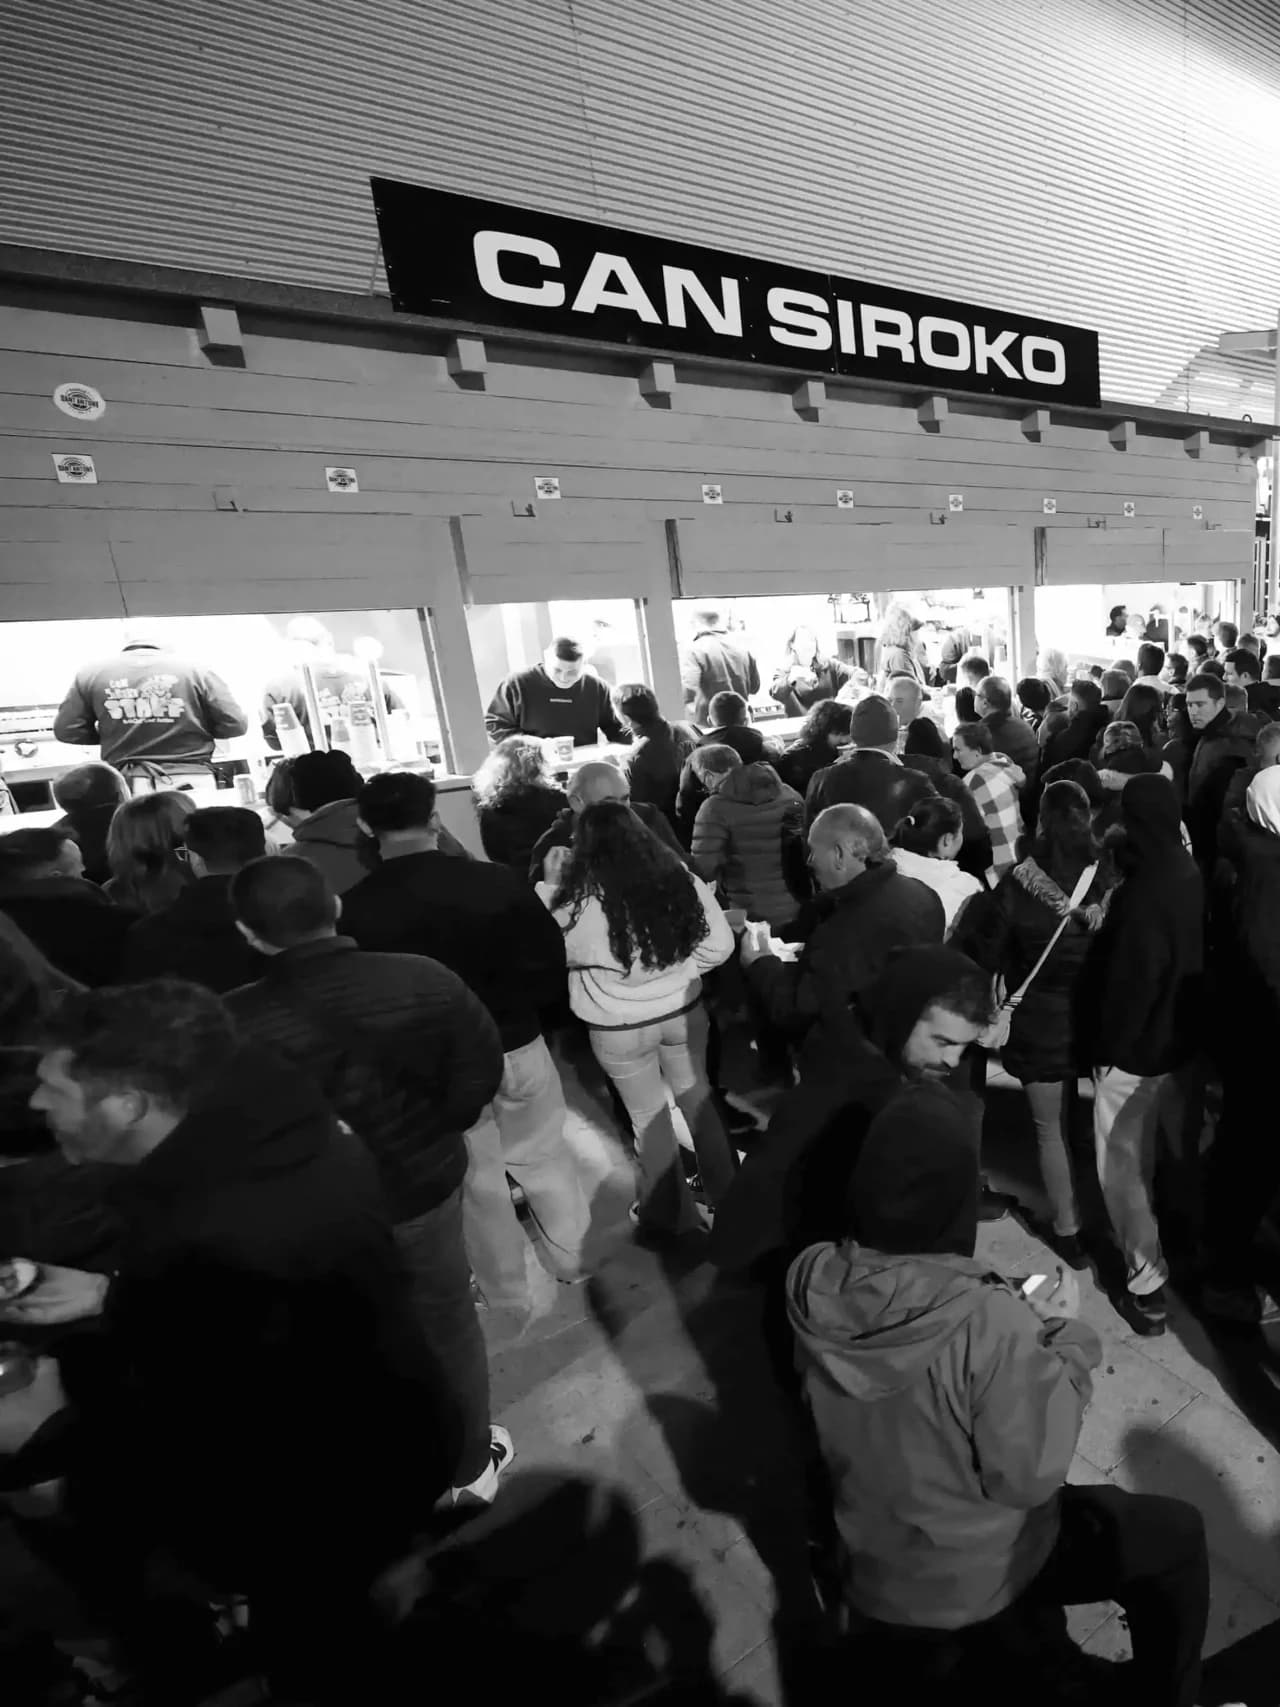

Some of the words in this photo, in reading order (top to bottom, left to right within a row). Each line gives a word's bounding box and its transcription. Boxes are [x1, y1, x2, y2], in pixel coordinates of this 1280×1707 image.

[473, 230, 743, 337] CAN
[767, 287, 1066, 385] SIROKO
[104, 698, 185, 719] STAFF
